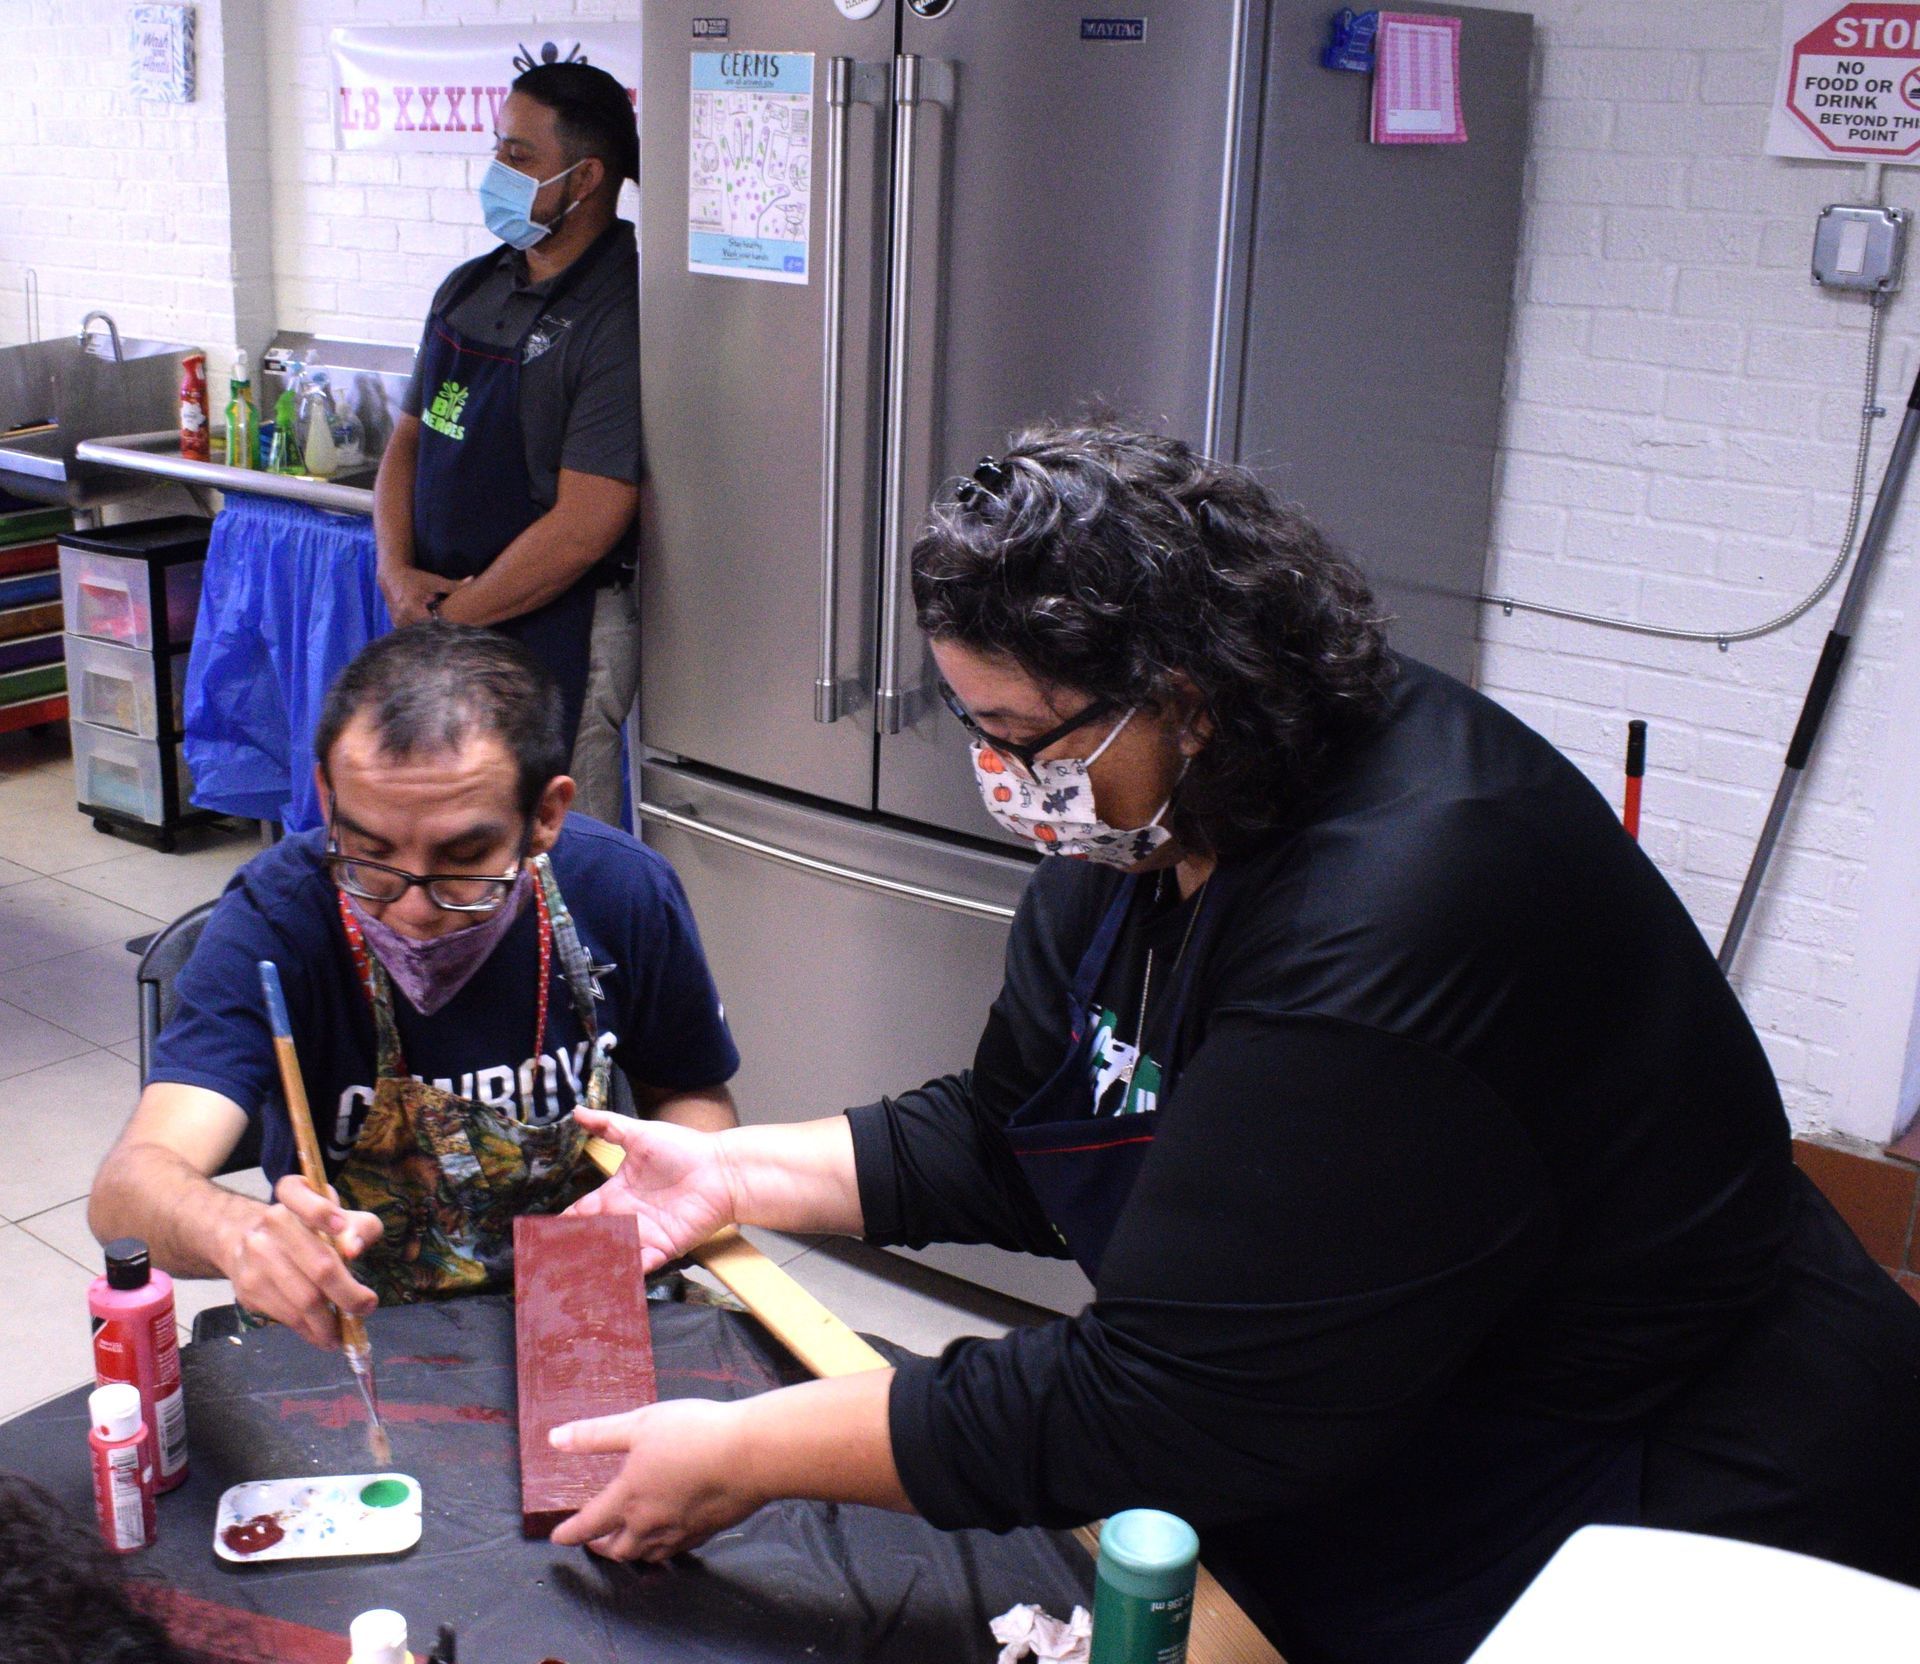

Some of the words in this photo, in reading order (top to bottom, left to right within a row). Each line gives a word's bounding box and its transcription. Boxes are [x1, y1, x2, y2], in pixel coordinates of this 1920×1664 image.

[694, 20, 709, 34] 10
[1084, 22, 1142, 36] MAYTAG
[1836, 61, 1865, 75] NO
[1805, 77, 1859, 92] FOOD
[1865, 79, 1893, 93] OR
[340, 87, 380, 130] LB
[1815, 94, 1878, 109] DRINK
[1820, 113, 1888, 127] BEYOND
[1893, 116, 1920, 129] THI
[1848, 128, 1899, 142] POINT
